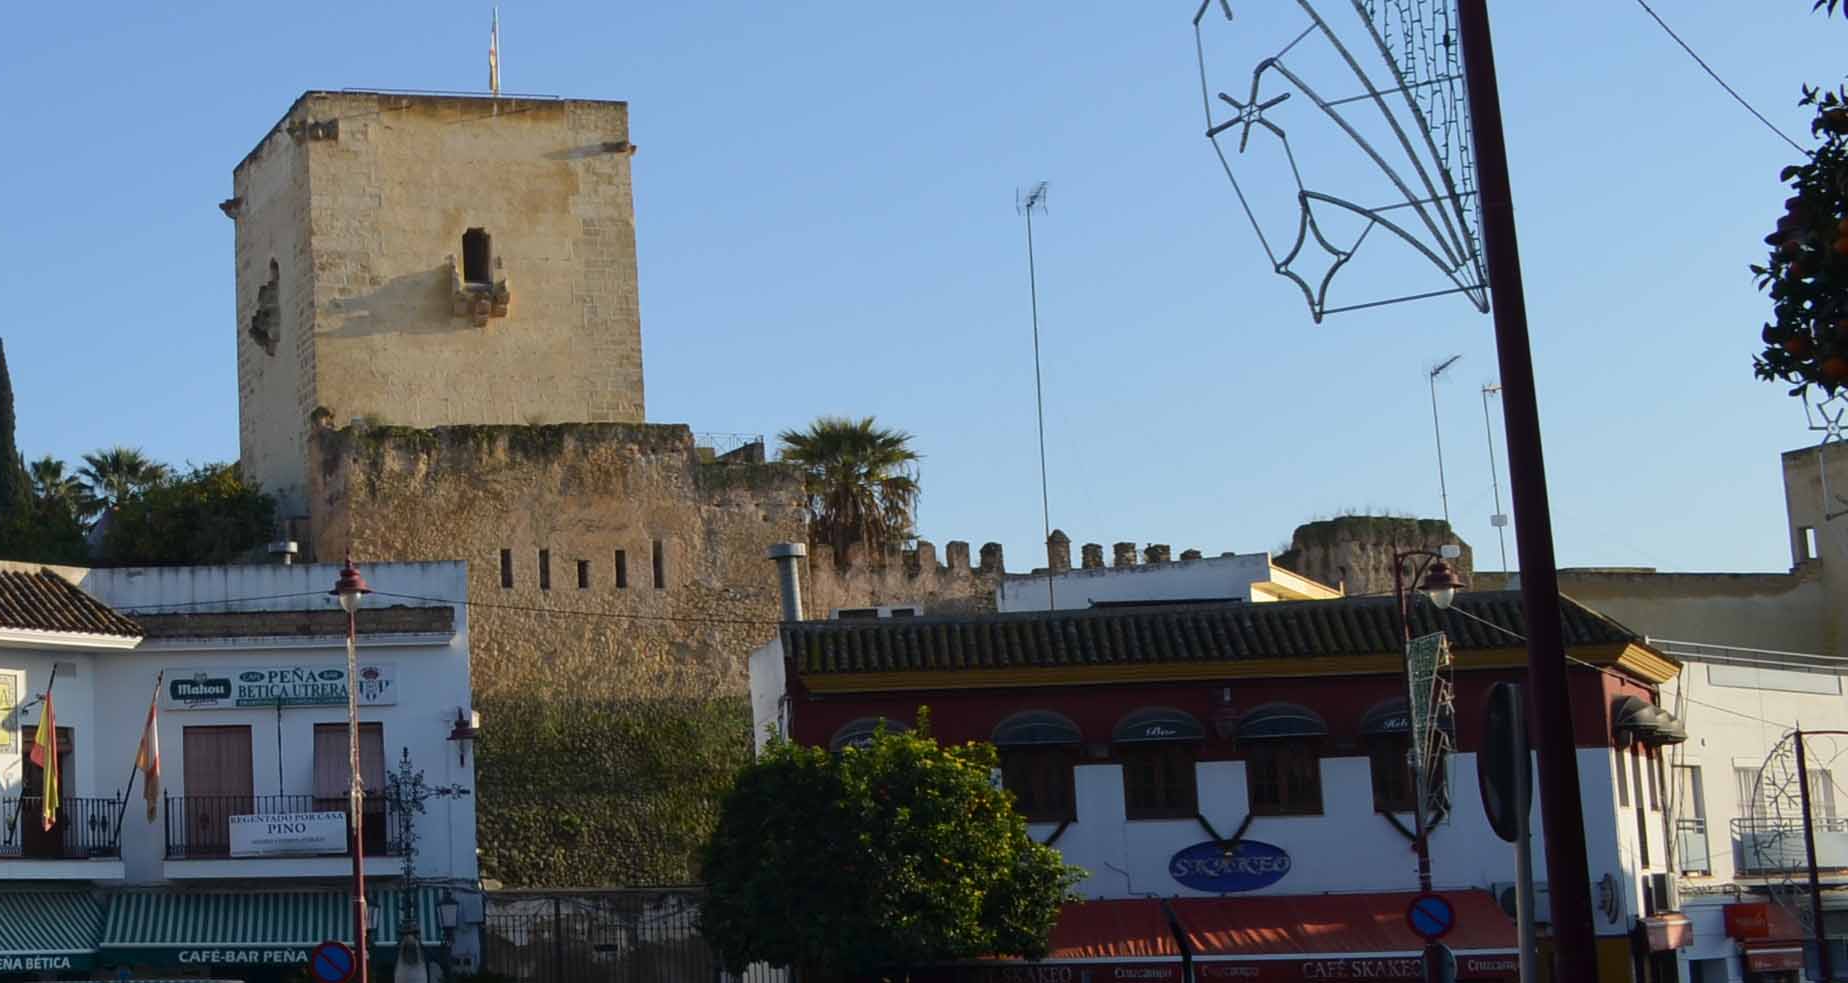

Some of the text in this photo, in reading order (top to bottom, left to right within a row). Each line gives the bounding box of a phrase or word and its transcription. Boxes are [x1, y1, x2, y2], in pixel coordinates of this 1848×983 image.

[267, 667, 317, 683] PEÑA
[178, 684, 225, 696] Mahou
[239, 683, 348, 698] BETICA UTRERA
[267, 822, 307, 834] PINO
[25, 954, 71, 970] BÉTICA
[178, 948, 309, 963] CAFÉ-BAR PEÑA
